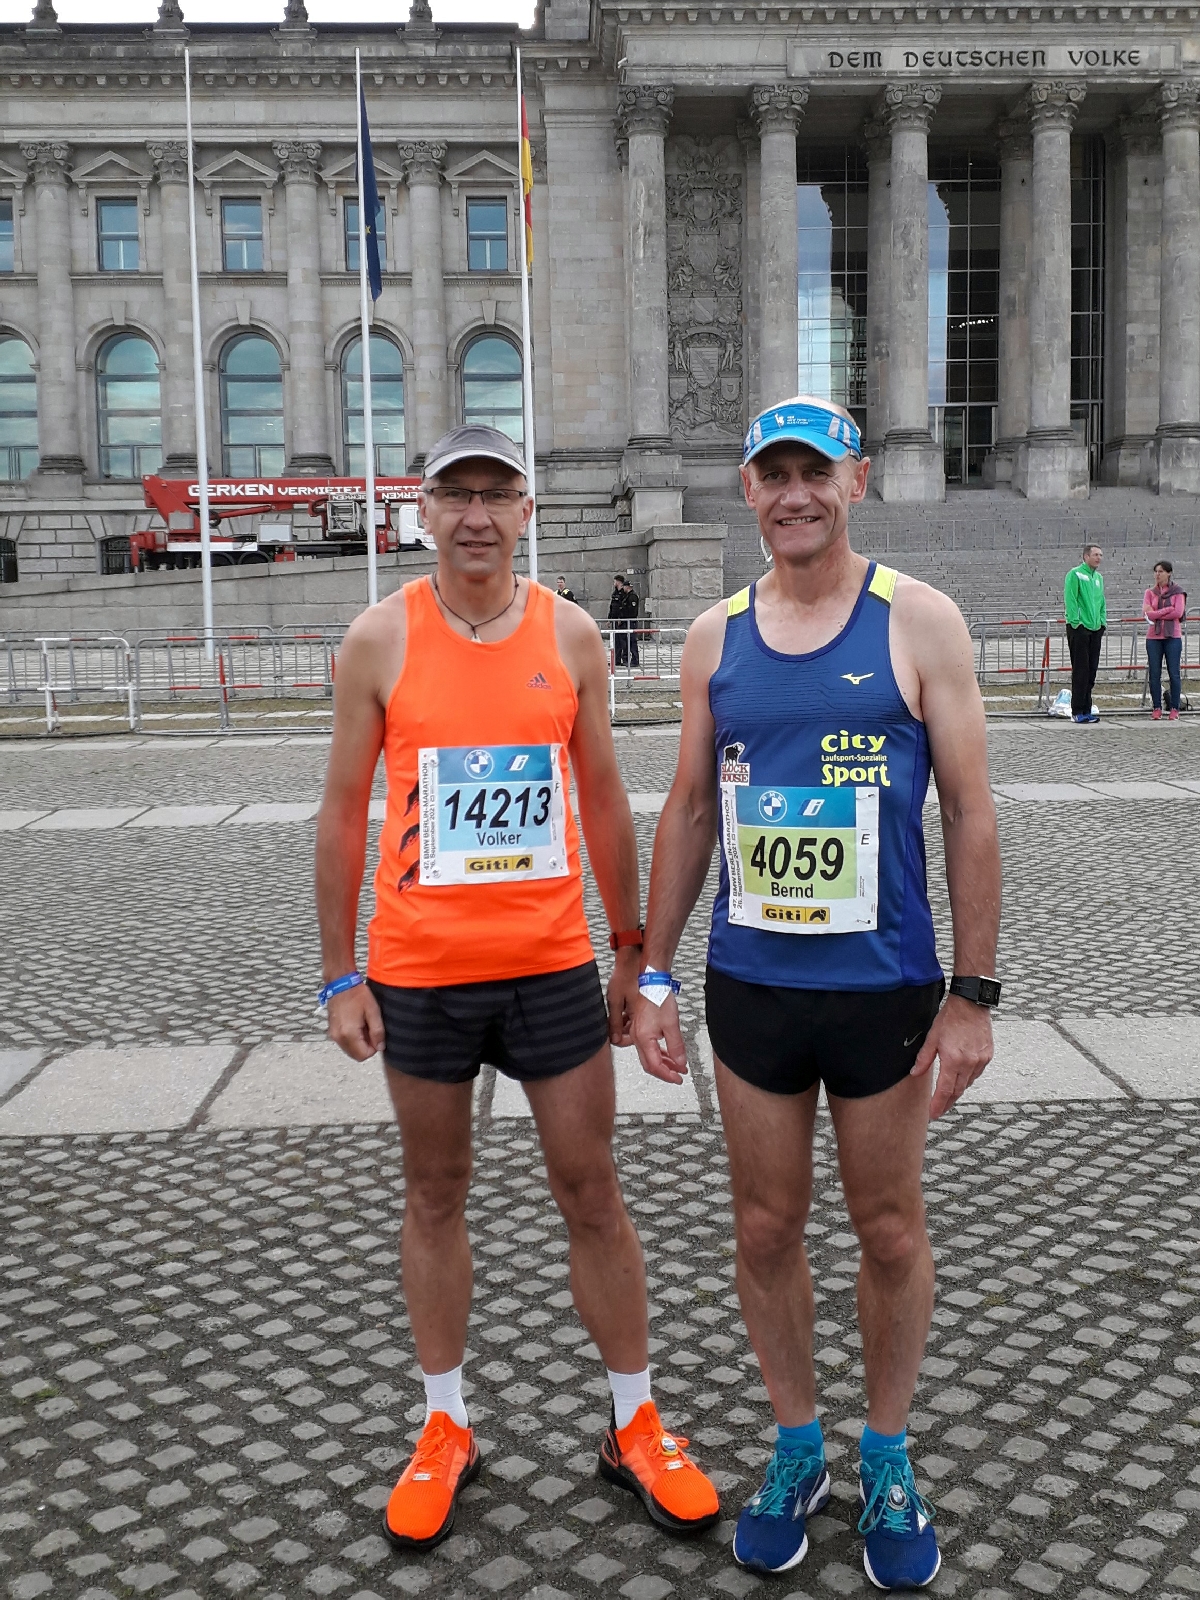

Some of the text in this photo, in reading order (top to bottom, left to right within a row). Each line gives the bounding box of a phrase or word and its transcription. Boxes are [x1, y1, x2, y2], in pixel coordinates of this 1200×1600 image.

[827, 49, 1141, 69] DEM DEUTSCHEN VOLKE
[188, 483, 273, 497] GERKEN
[820, 729, 887, 753] City
[821, 753, 888, 762] Laufsport-Spezialist
[821, 763, 891, 788] Sport
[444, 787, 552, 830] 14213
[476, 832, 522, 846] Volker
[860, 833, 870, 845] E
[469, 859, 508, 871] Giti
[750, 835, 845, 881] 4059
[771, 881, 814, 898] Bernd
[765, 908, 801, 921] Giti
